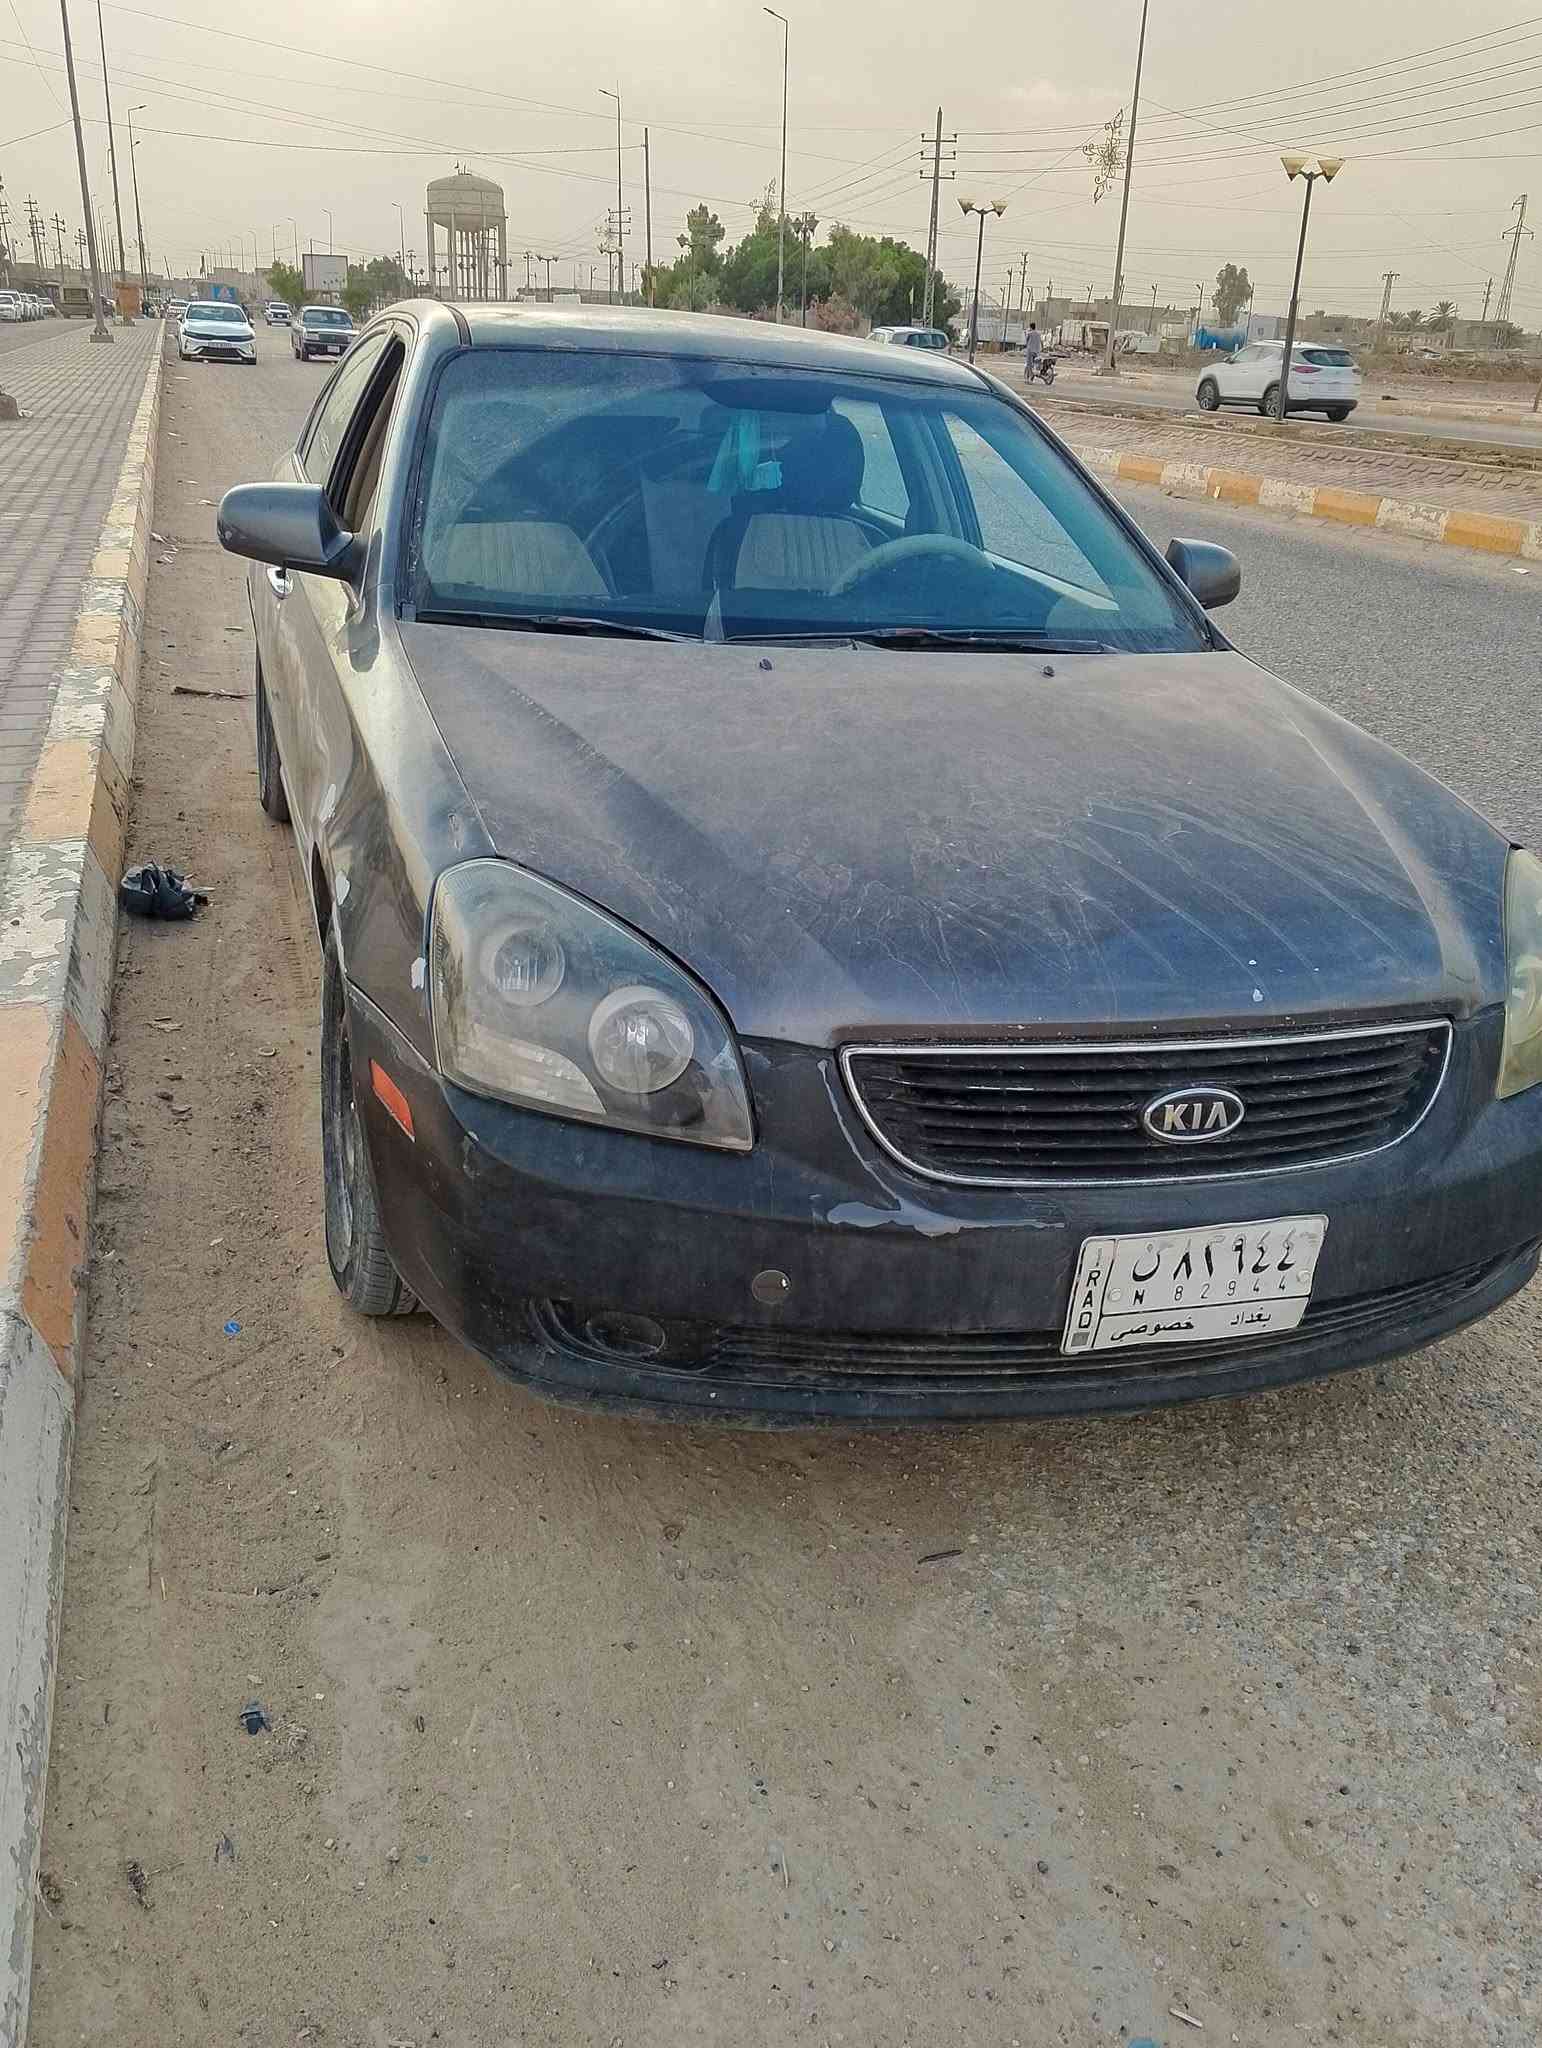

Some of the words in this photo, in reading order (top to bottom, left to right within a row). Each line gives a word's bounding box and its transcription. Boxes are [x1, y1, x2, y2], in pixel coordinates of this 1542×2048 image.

[1162, 1101, 1228, 1131] KIA
[1079, 1247, 1102, 1329] IRAQ
[1174, 1276, 1286, 1302] 82944
[1110, 1316, 1194, 1341] خصوصي
[1230, 1306, 1271, 1328] بغداد
